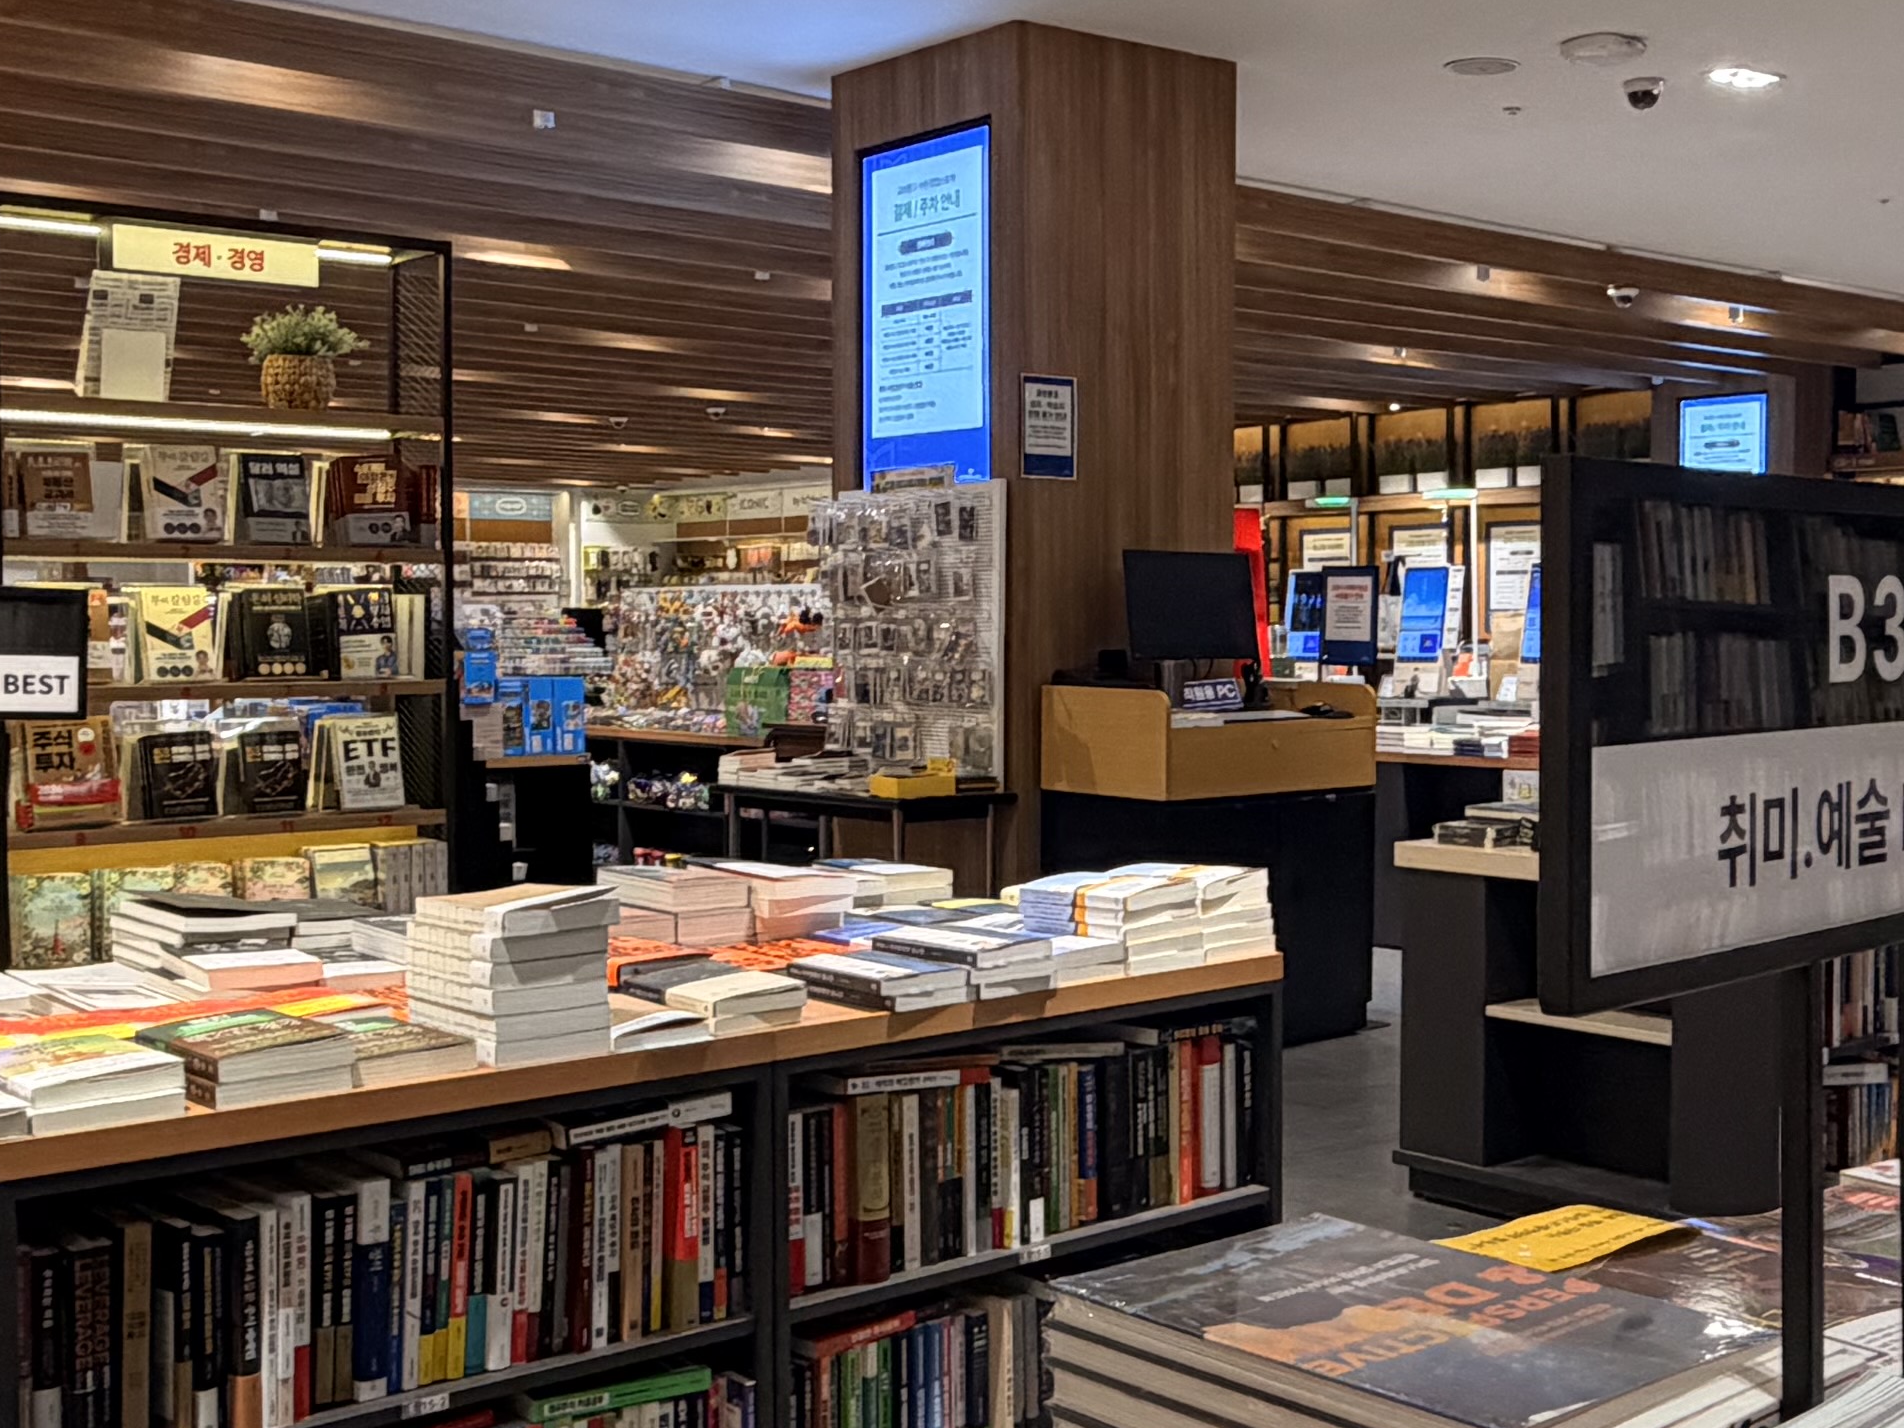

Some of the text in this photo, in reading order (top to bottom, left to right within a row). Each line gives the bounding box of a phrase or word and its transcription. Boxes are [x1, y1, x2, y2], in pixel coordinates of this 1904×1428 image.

[1, 672, 72, 697] BEST
[1216, 683, 1237, 700] PC
[342, 737, 397, 763] ETF
[1717, 780, 1892, 889] 취미.예술
[74, 1259, 94, 1371] LEVERAGE
